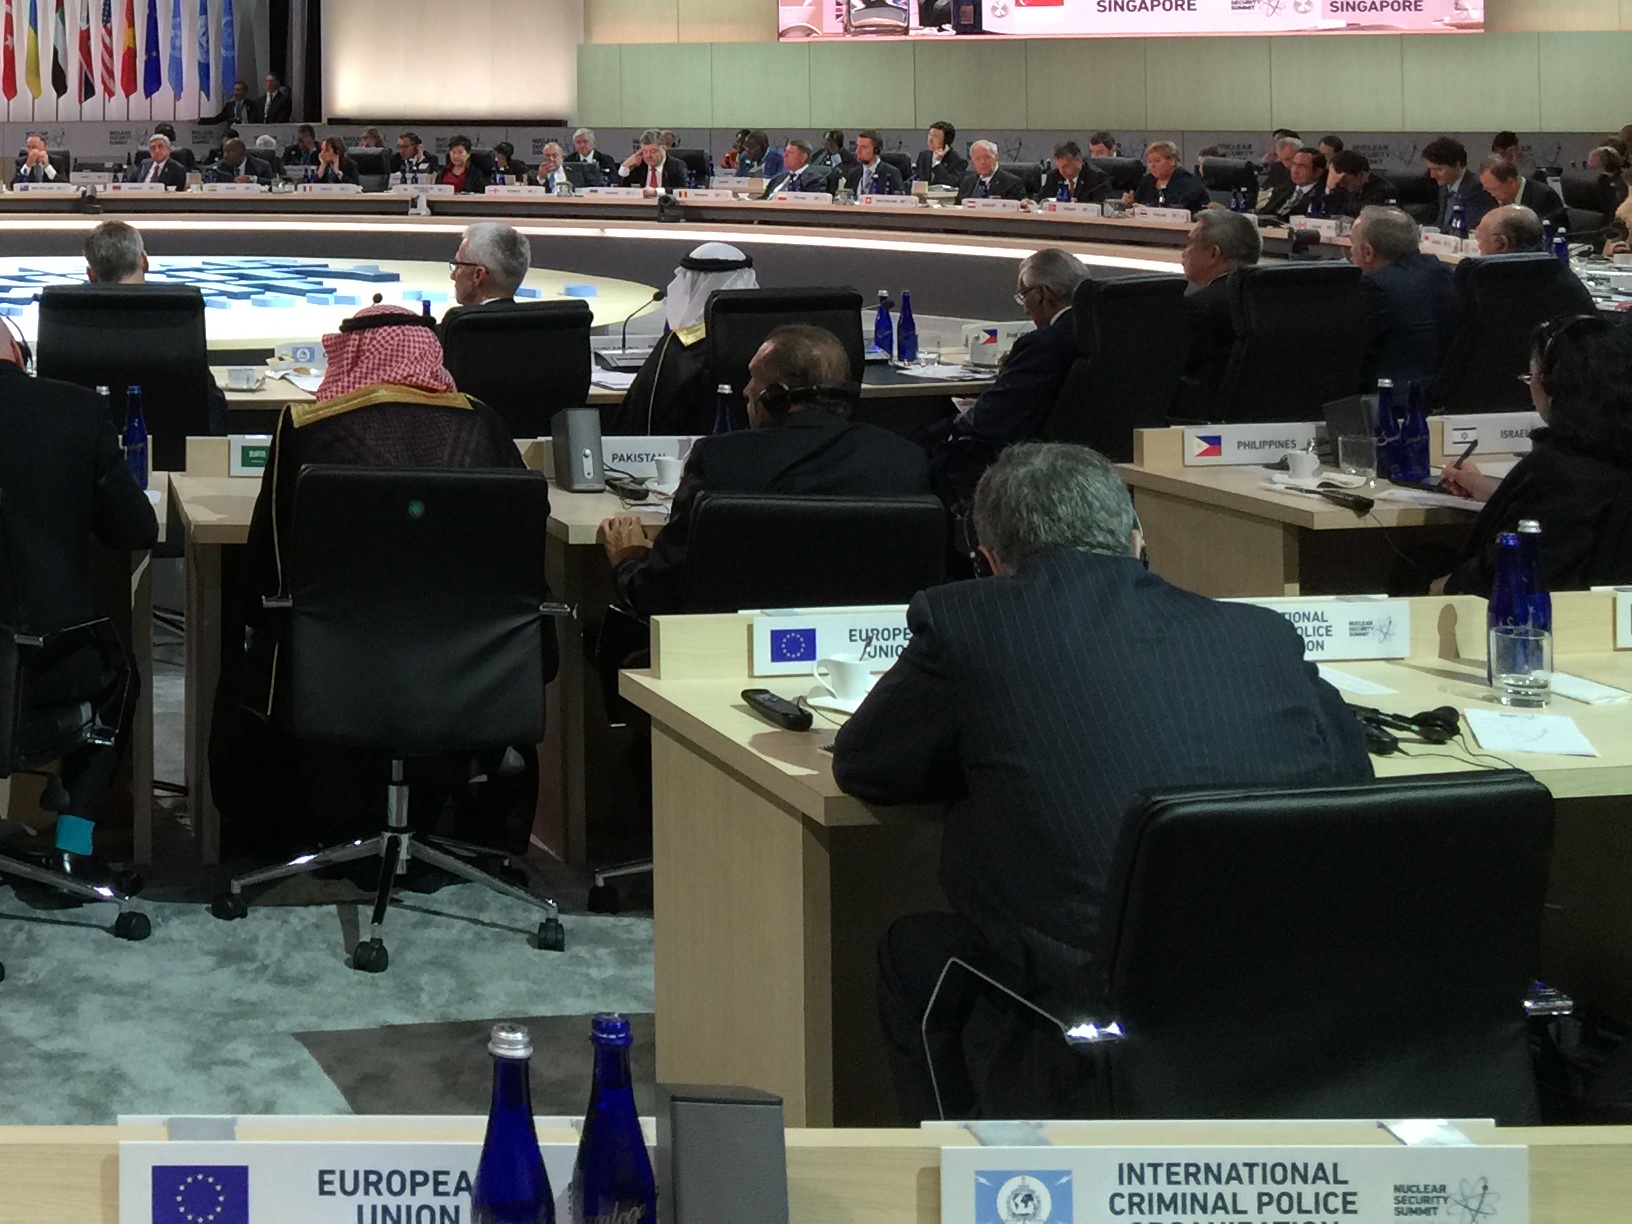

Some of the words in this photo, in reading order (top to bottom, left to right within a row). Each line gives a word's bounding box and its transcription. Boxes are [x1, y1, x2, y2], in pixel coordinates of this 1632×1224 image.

[1329, 0, 1424, 14] SINGAPORE
[1237, 439, 1297, 451] PHILIPPINES
[848, 626, 912, 643] EUROPE
[1296, 625, 1333, 638] OLICE
[867, 643, 905, 659] UNIO
[1117, 1161, 1349, 1186] INTERNATIONAL
[318, 1169, 473, 1198] EUROPEA
[1393, 1184, 1447, 1194] NUCLEAR
[1108, 1191, 1248, 1216] CRIMINAL
[1256, 1191, 1359, 1215] POLICE
[1393, 1195, 1449, 1205] SECURITY
[357, 1203, 461, 1224] UNION
[1393, 1205, 1439, 1216] SUMMIT
